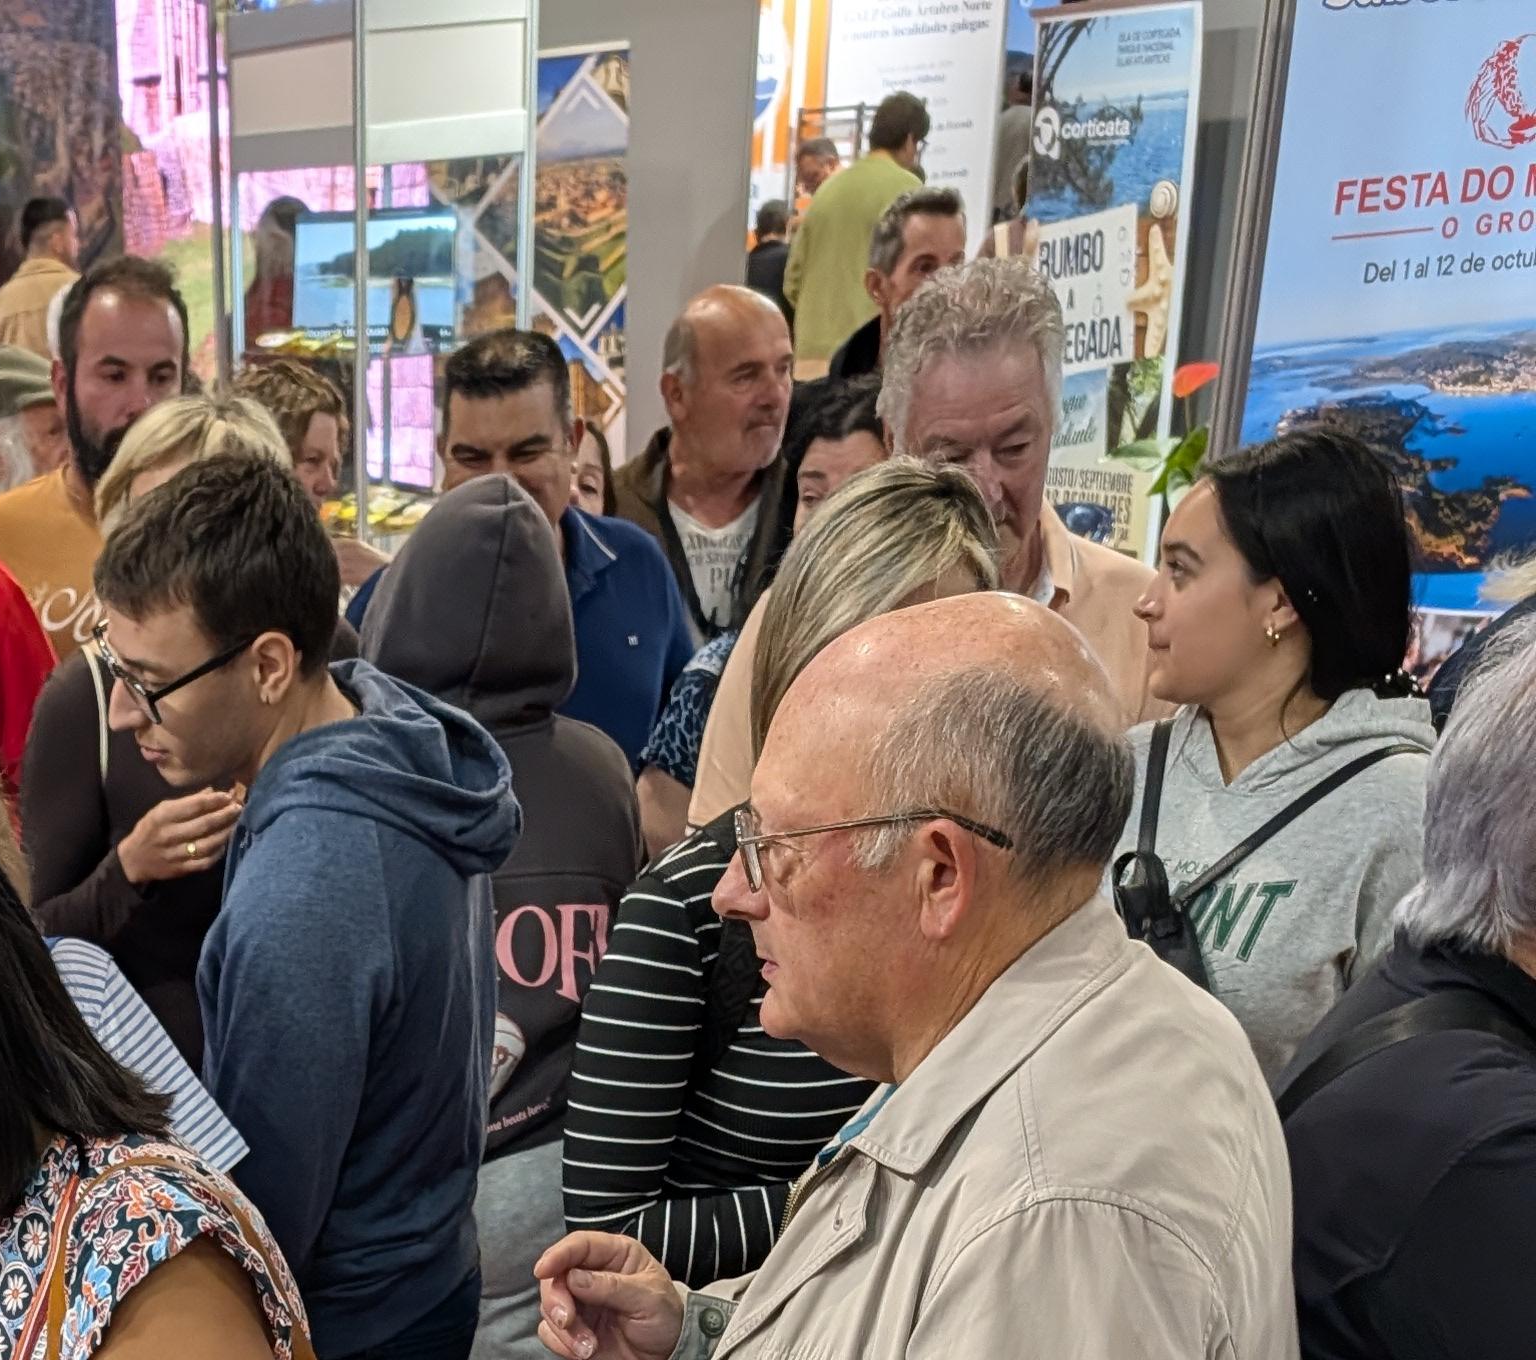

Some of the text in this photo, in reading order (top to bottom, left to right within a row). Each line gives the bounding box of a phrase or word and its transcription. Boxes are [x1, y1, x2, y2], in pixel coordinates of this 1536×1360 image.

[1061, 117, 1131, 140] corticata
[1334, 171, 1450, 215] FESTA
[1460, 165, 1514, 204] DO
[1441, 216, 1459, 240] O
[1363, 246, 1536, 284] Del 1 al 12 de octu
[1066, 289, 1075, 310] A
